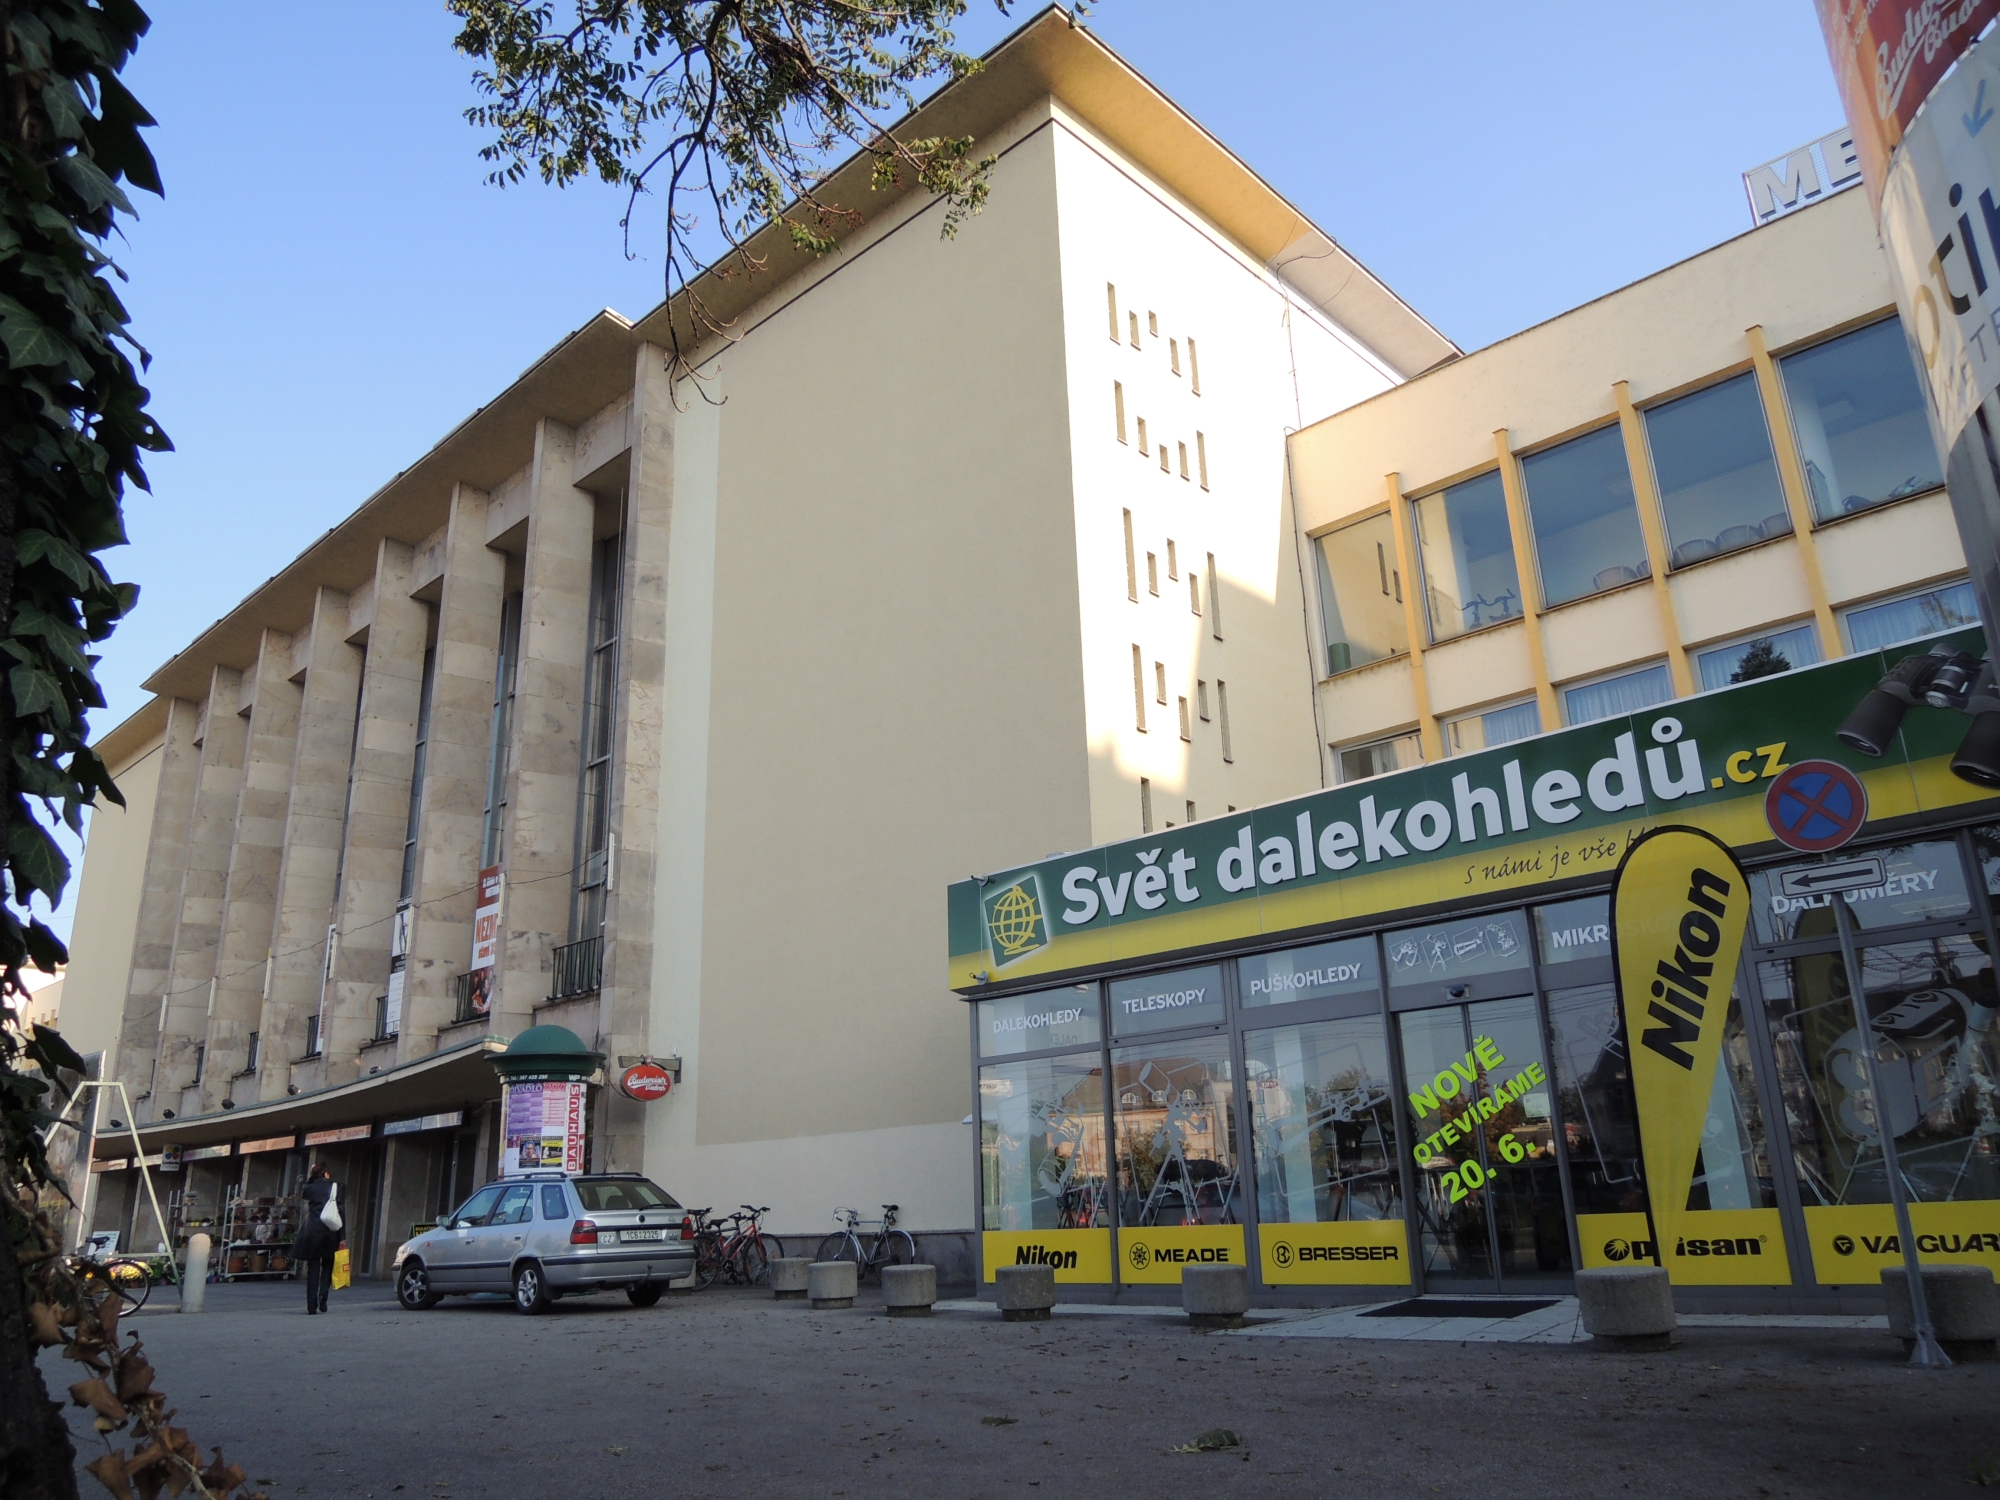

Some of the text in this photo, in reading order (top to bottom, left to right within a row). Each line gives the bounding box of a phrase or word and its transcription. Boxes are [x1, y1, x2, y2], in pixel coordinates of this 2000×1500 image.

[1061, 717, 1789, 924] Svět dalekohledů.cz
[1482, 850, 1543, 880] námi
[1548, 845, 1570, 878] je
[1578, 837, 1617, 861] vše
[1250, 963, 1362, 996] PUŠKOHLEDY
[1641, 867, 1732, 1069] Nikon
[1122, 988, 1206, 1014] TELESKOPY
[993, 1007, 1082, 1034] DALEKOHLEDY
[510, 1084, 543, 1094] DIVADLO
[628, 1073, 668, 1089] Budweiser
[1408, 1034, 1506, 1119] NOVĚ
[1413, 1062, 1547, 1164] OTEVÍRÁME
[567, 1086, 580, 1170] BAUHAUS
[1441, 1159, 1497, 1205] 20.
[1498, 1133, 1537, 1164] 6.
[602, 1235, 612, 1244] CZ
[643, 1230, 659, 1239] 2325
[1015, 1245, 1077, 1269] Nikon
[1154, 1248, 1230, 1262] MEADE
[1299, 1246, 1399, 1261] BRESSER
